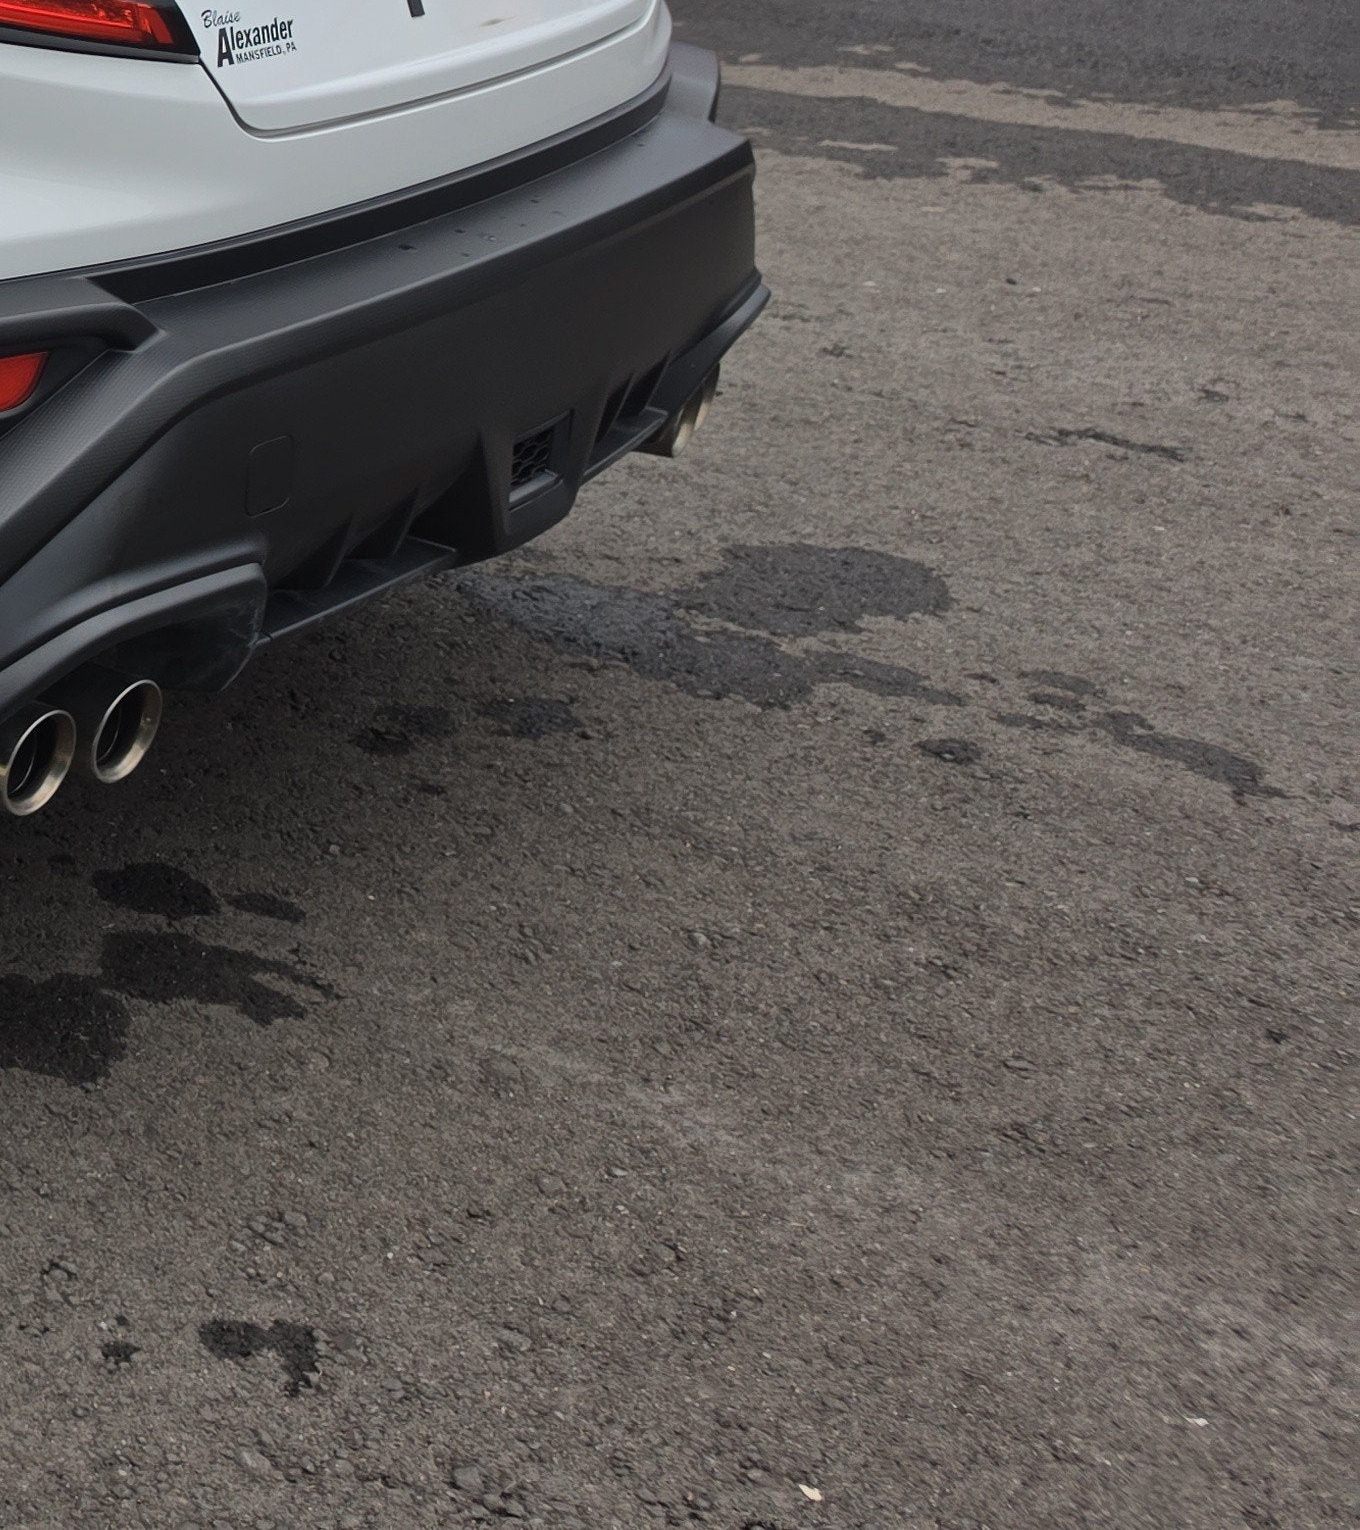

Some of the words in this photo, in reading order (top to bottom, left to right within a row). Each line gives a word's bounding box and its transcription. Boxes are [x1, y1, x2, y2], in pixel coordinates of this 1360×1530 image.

[200, 9, 241, 29] Blaise
[217, 17, 294, 68] Alexander
[235, 47, 286, 64] MANSFIELD,
[286, 41, 297, 53] PA
